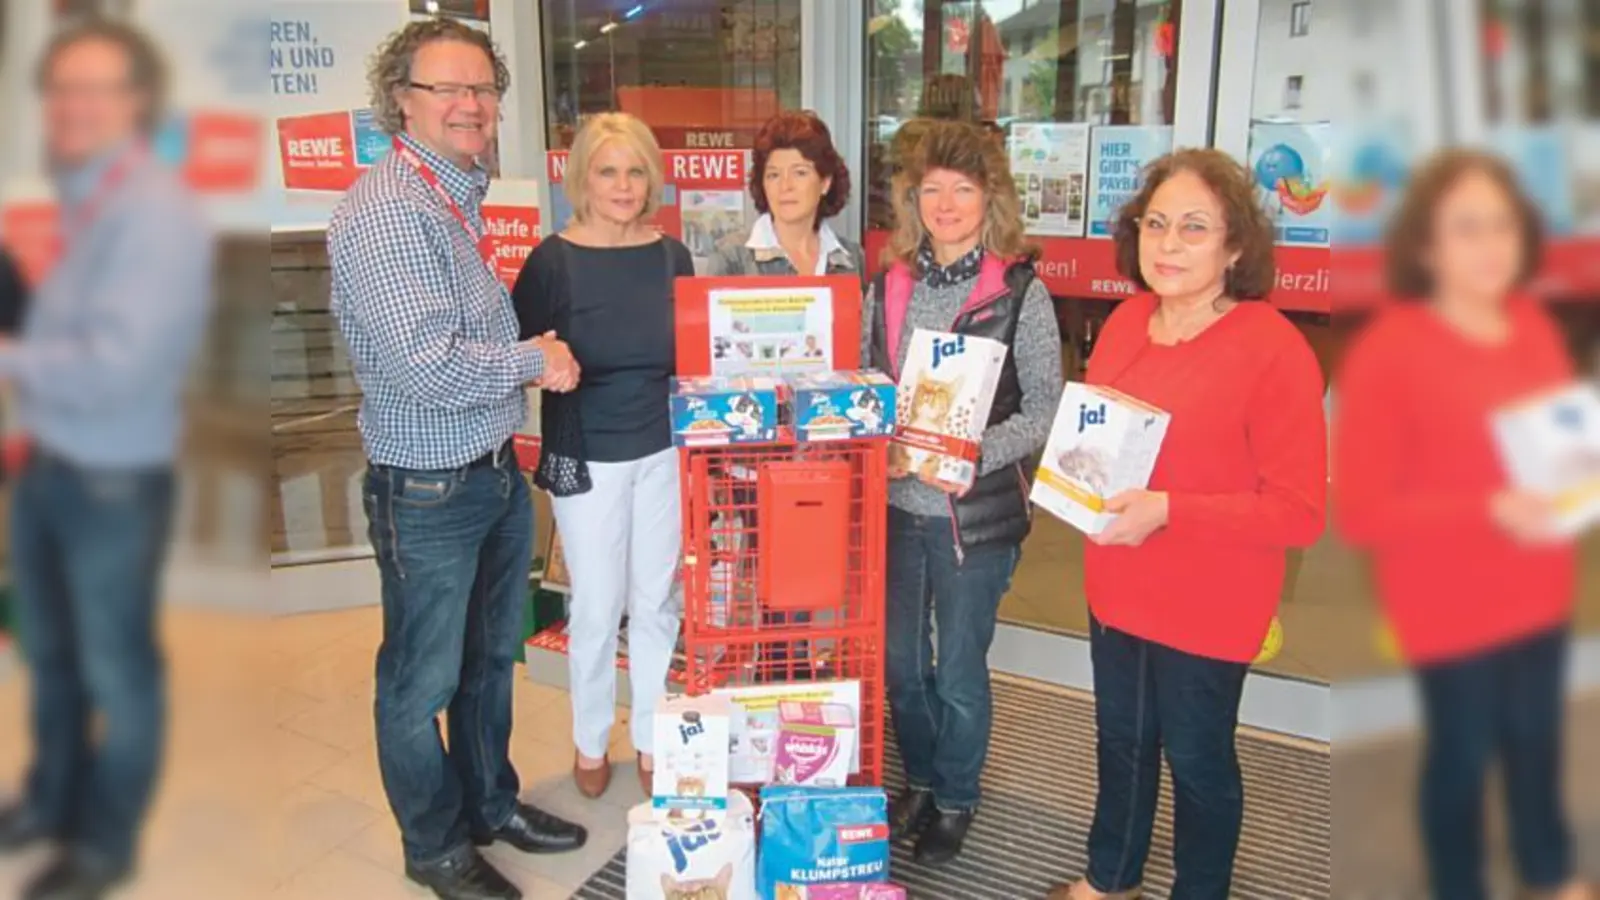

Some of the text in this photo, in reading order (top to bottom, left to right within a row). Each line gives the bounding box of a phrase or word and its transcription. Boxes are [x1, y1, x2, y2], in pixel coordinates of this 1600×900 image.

[290, 46, 334, 69] UND
[270, 72, 318, 94] TEN!
[287, 136, 345, 158] REWE
[685, 132, 735, 147] REWE
[1100, 142, 1131, 157] HIER
[672, 154, 738, 179] REWE
[931, 334, 966, 369] ja!
[1078, 403, 1107, 433] ja!
[677, 718, 704, 745] ja!
[790, 858, 884, 882] KLUMPSTREU
